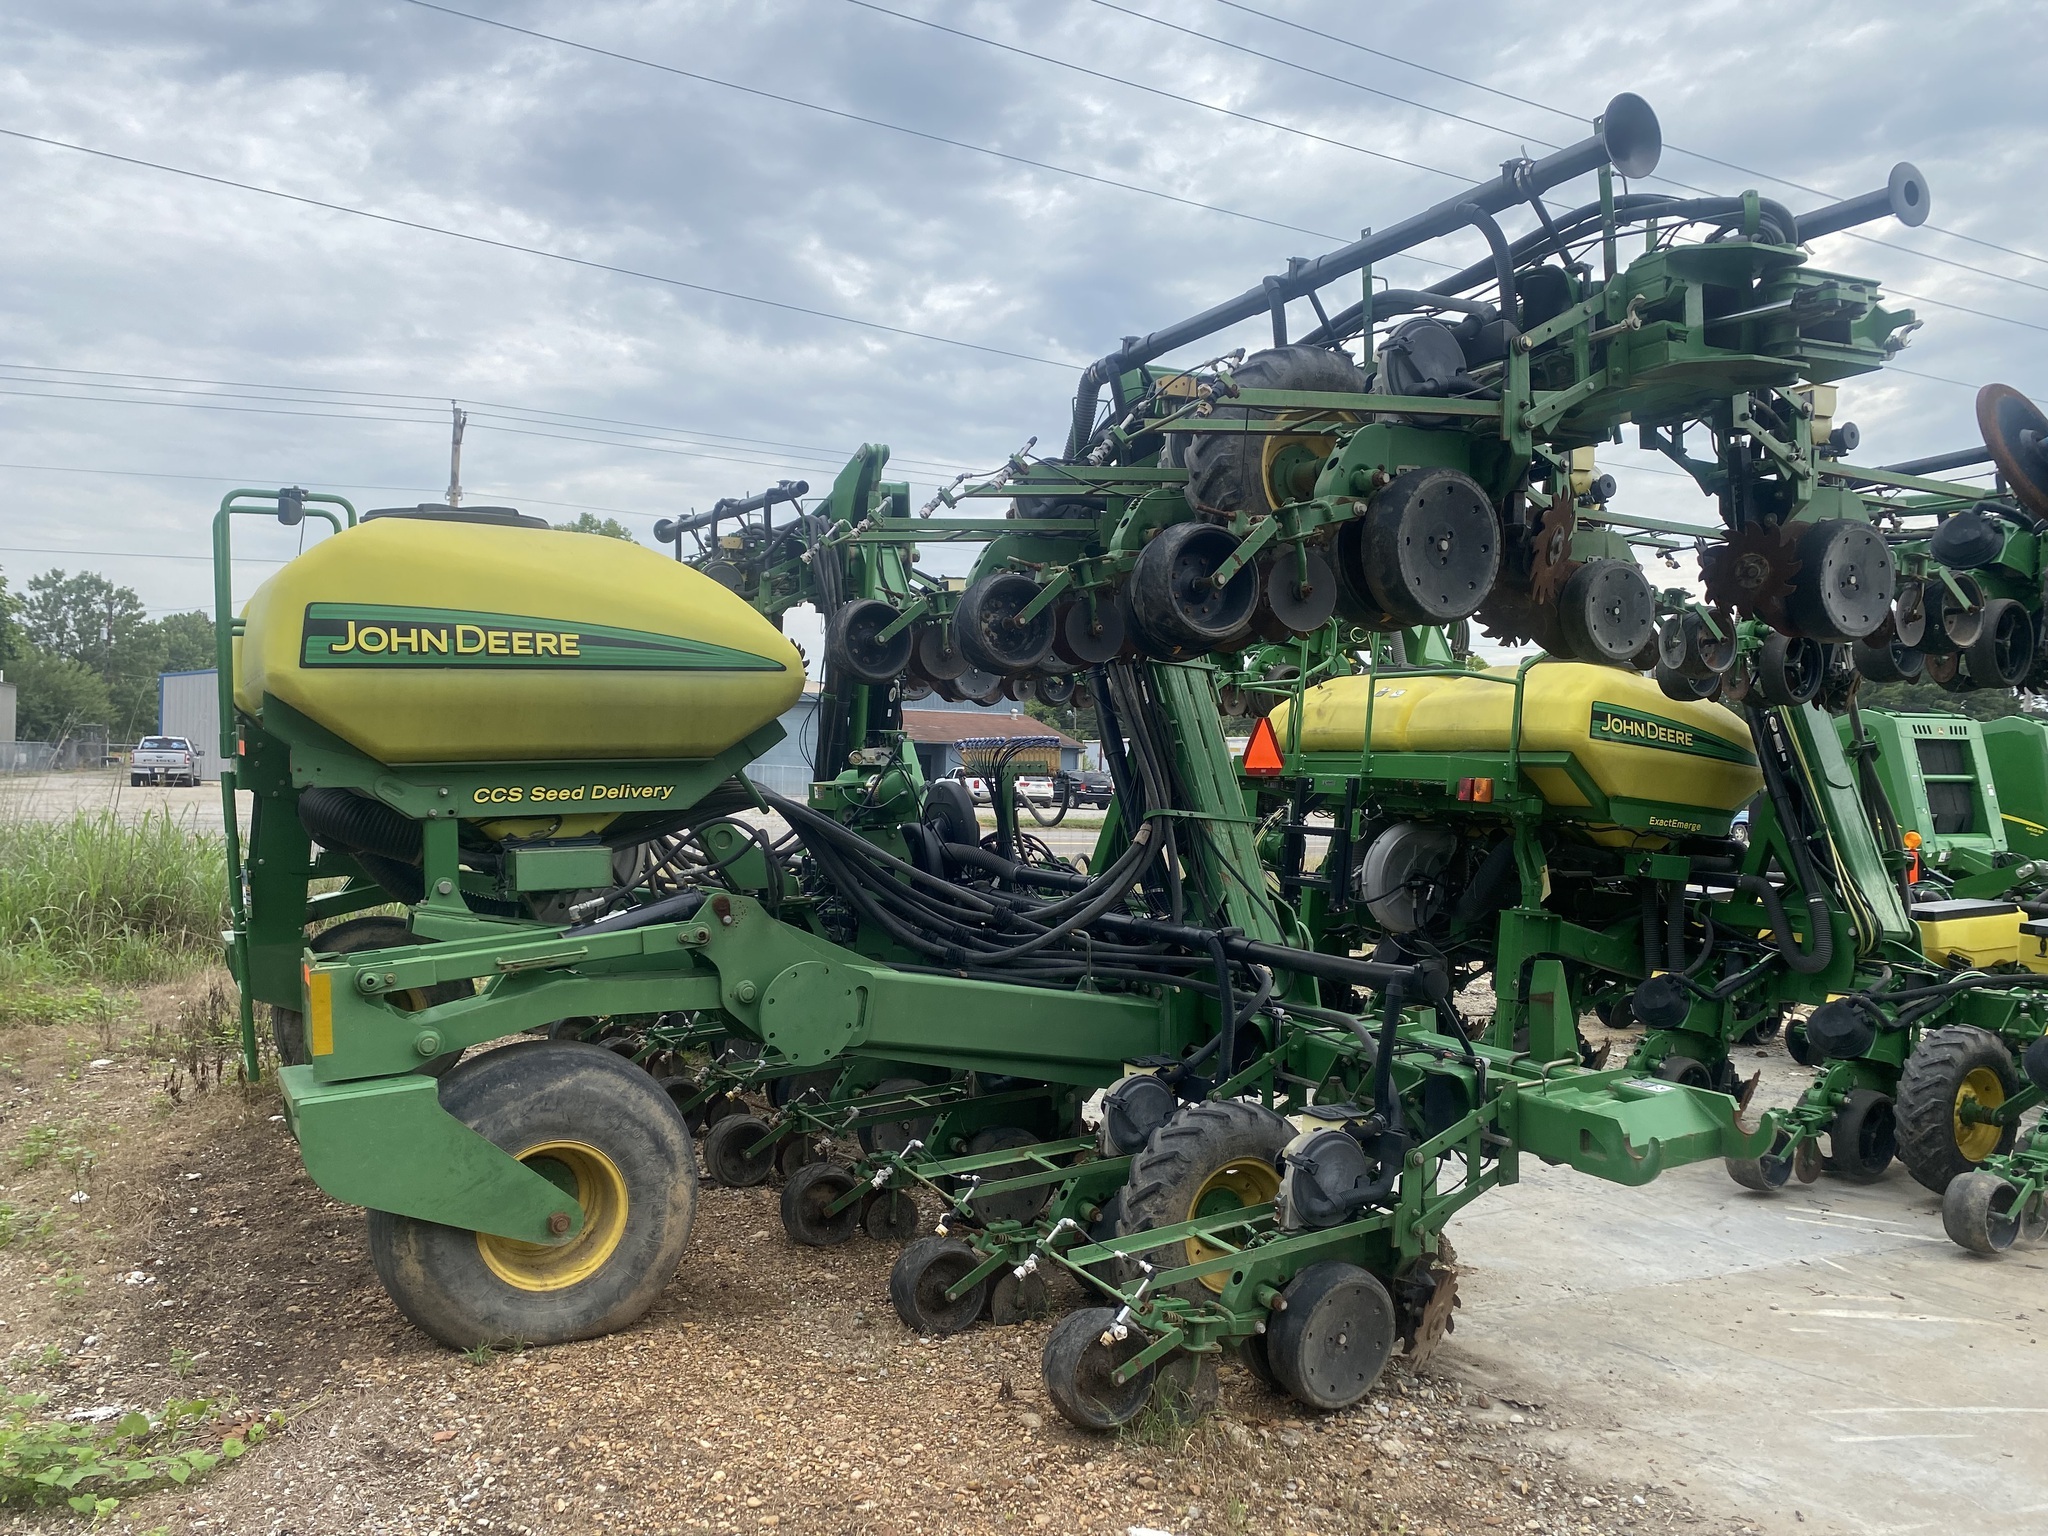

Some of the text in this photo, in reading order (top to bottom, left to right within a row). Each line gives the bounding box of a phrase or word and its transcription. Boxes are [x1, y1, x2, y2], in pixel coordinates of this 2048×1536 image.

[331, 620, 581, 656] JOHN DEERE
[1601, 713, 1693, 746] JOHN DEERE
[473, 784, 674, 803] CCS Seed Delivery
[1649, 816, 1702, 832] ExactEmerge
